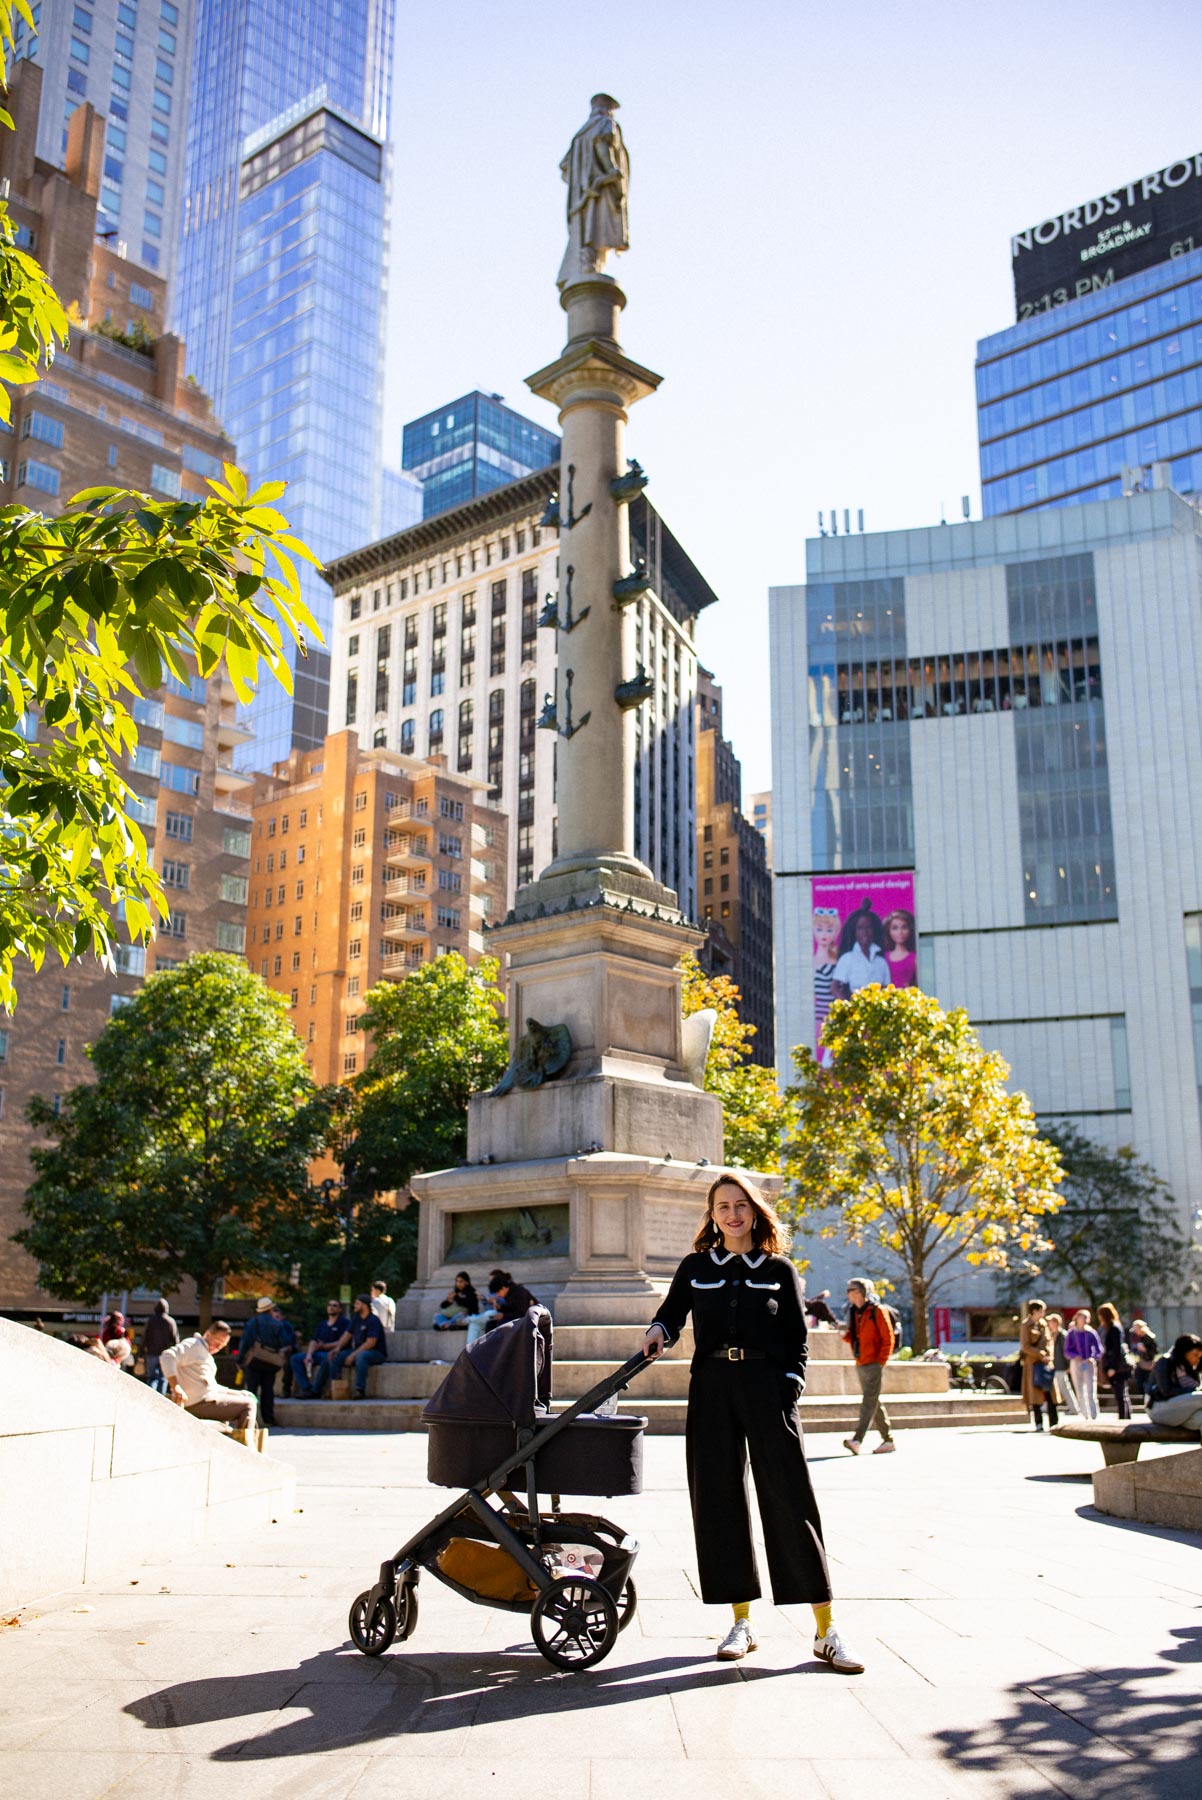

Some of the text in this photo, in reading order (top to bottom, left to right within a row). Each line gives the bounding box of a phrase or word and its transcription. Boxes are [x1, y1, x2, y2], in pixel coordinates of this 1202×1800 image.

[1123, 220, 1132, 232] &
[1080, 221, 1152, 261] BROADWAY
[1019, 268, 1115, 320] 2:13 PM
[815, 879, 910, 892] museum of arts and design
